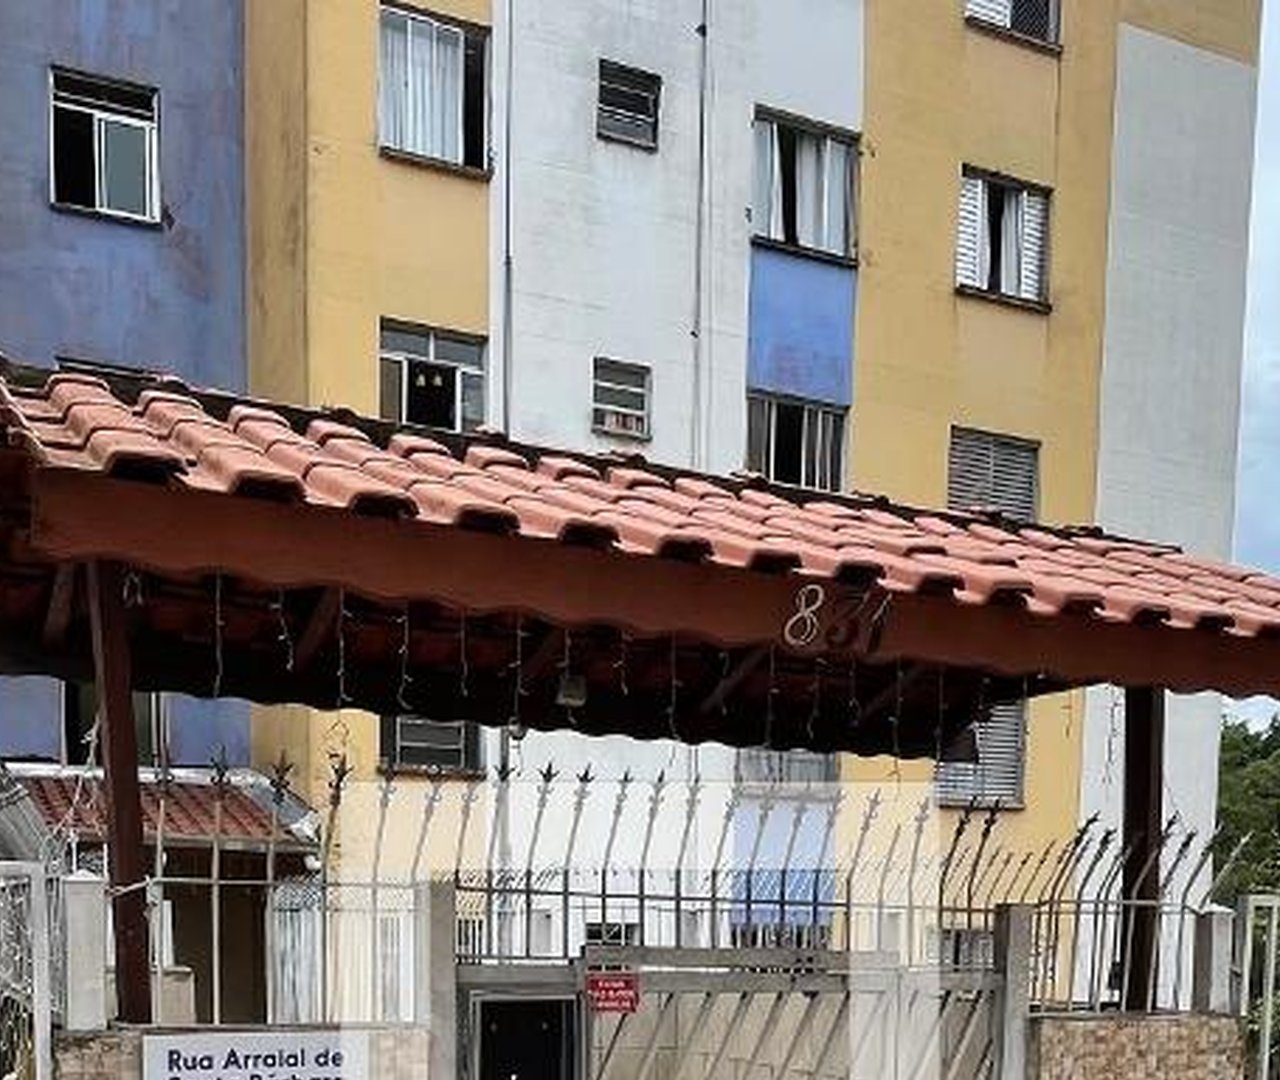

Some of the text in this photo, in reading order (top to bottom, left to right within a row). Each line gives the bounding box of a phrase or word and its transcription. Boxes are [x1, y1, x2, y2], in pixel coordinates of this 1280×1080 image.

[168, 1048, 344, 1072] Rua Arraial de
